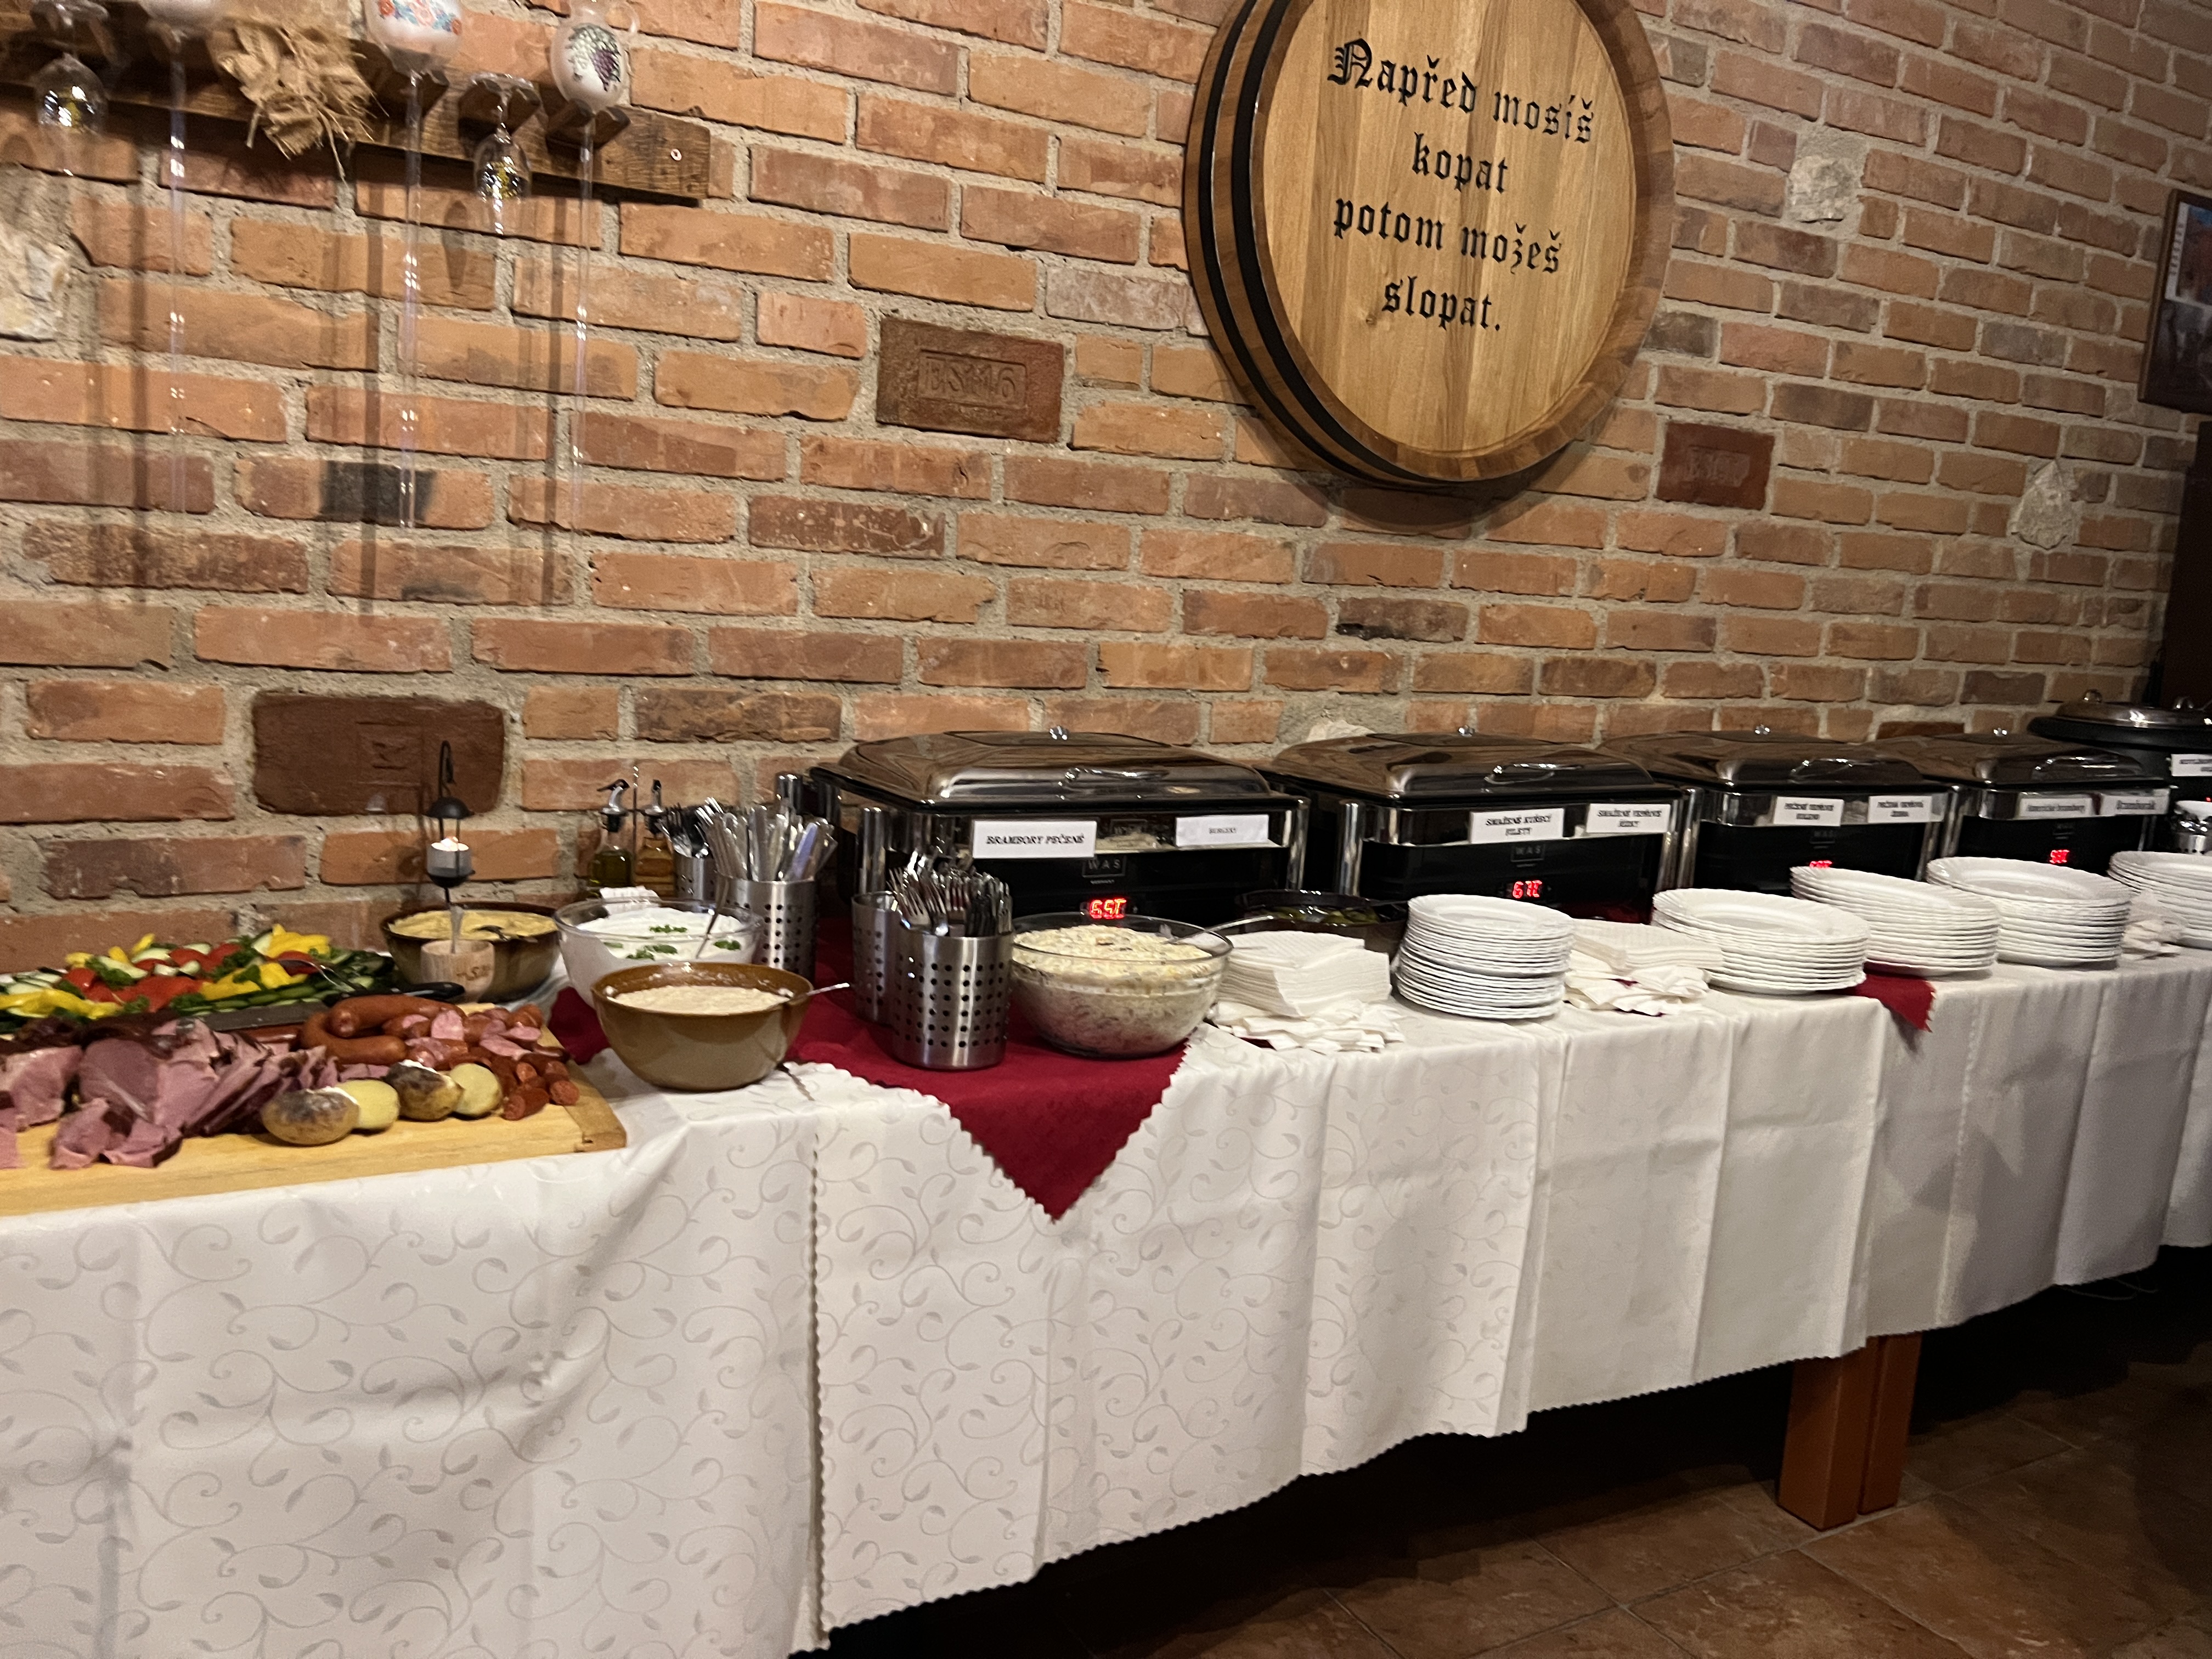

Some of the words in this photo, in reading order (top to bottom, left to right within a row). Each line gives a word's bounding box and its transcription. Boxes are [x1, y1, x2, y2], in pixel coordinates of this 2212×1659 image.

[1327, 38, 1477, 114] Napřed
[1492, 95, 1594, 143] mosíš
[1412, 132, 1509, 193] kopat
[1333, 198, 1444, 250] potom
[1460, 222, 1562, 274] možeš
[1381, 276, 1500, 331] slopat.
